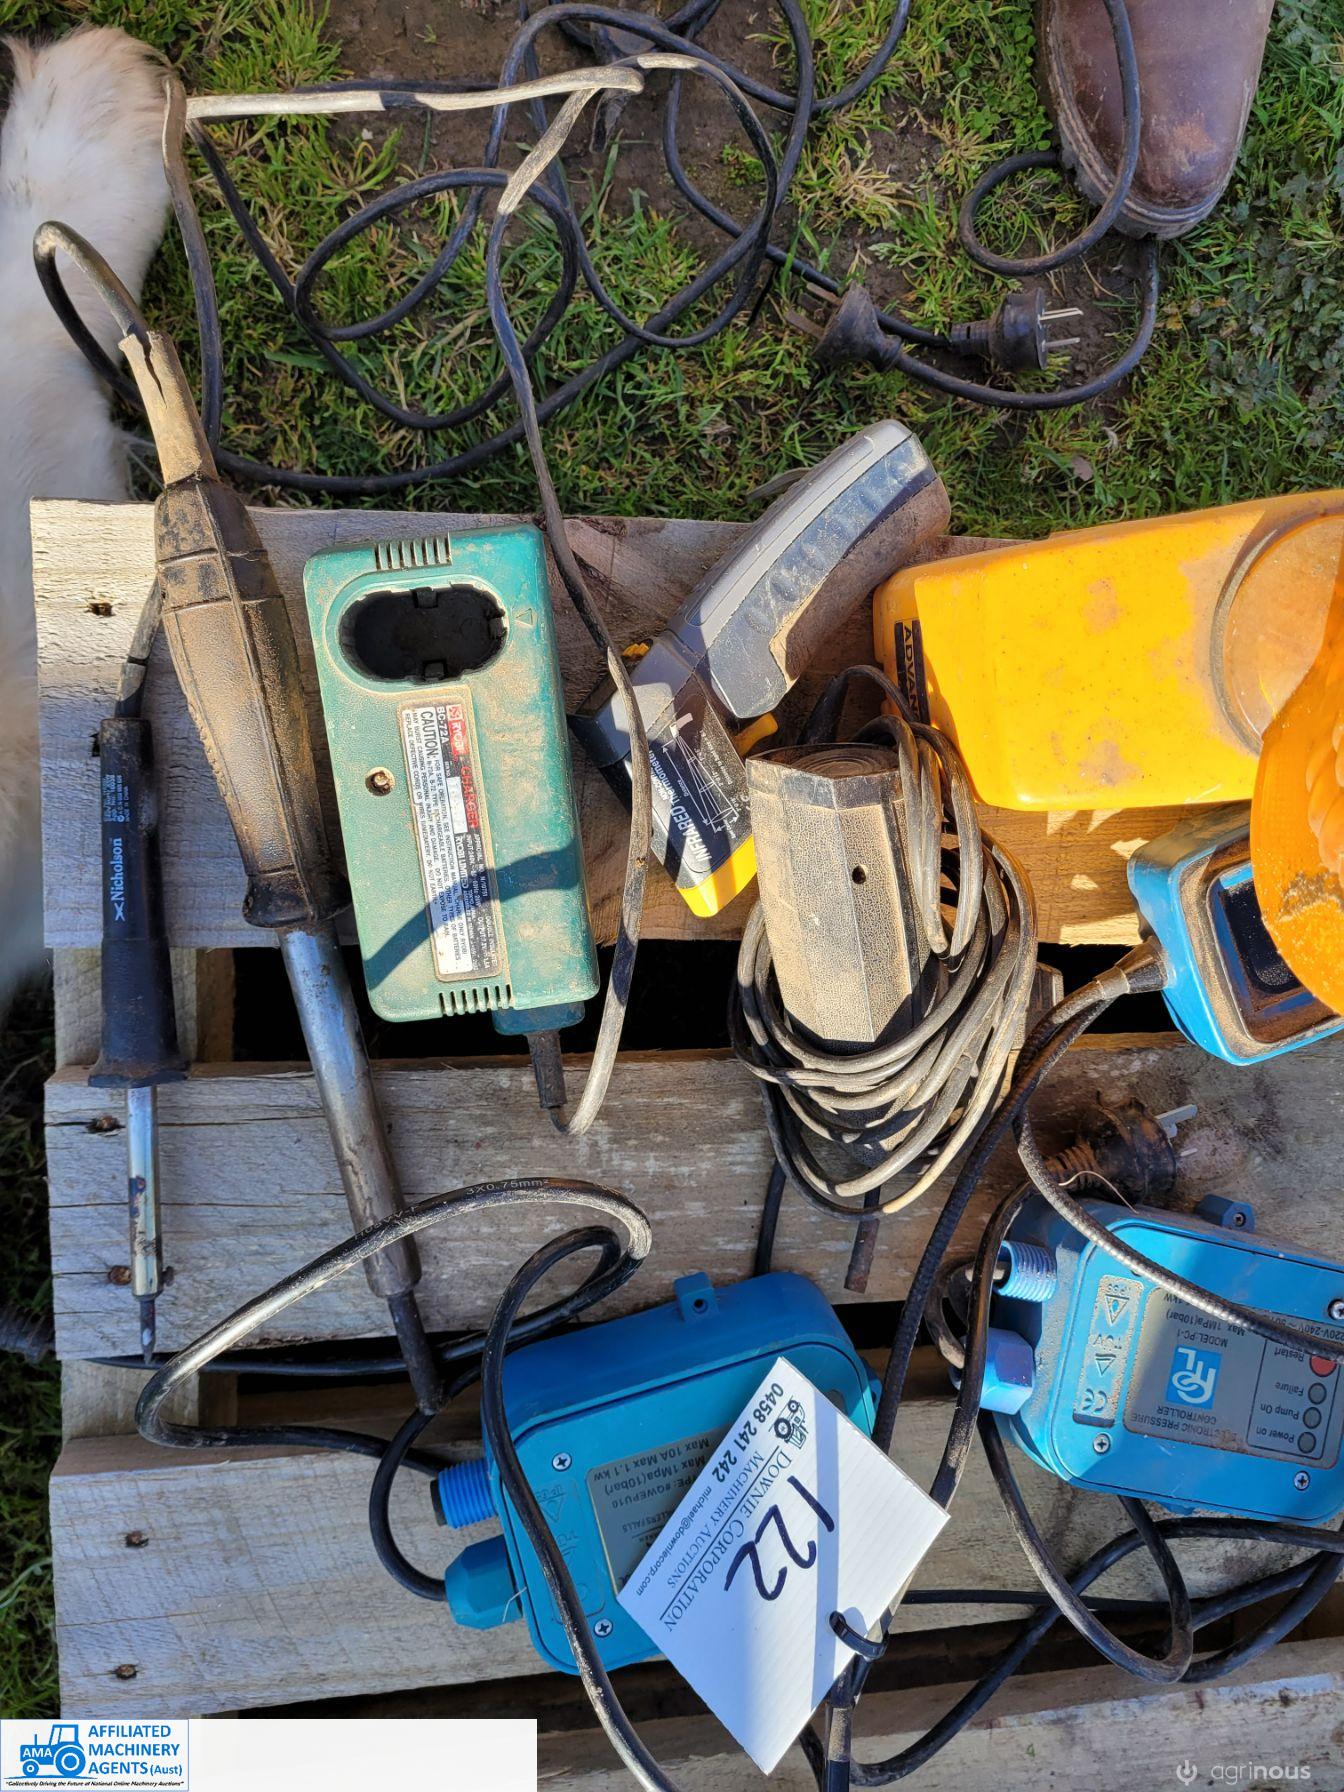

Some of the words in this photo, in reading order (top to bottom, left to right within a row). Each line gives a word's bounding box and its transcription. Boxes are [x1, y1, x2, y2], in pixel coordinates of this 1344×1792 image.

[404, 713, 413, 737] REPLACE
[419, 710, 439, 758] CAUTION:
[436, 706, 449, 743] BC-72A
[451, 721, 465, 752] RYOBI
[408, 739, 417, 768] DEFECTIVE
[416, 745, 425, 770] CAUSING
[420, 772, 430, 801] PERSONAL
[460, 765, 480, 828] CHARGER
[425, 802, 433, 822] INJURY
[455, 835, 464, 858] RYOBI
[473, 833, 482, 861] APPROVAL
[671, 804, 712, 862] INFRARED
[445, 834, 454, 869] INSTRUCTION
[108, 837, 124, 901] Nicholson
[458, 859, 469, 888] LIMITED
[438, 891, 446, 912] EXPOSE
[444, 885, 452, 903] OTHER
[1164, 1308, 1222, 1331] 1MPa(10bar)
[1176, 1328, 1228, 1347] MODEL:PC-1
[1273, 1347, 1304, 1362] Restart
[753, 1383, 784, 1422] 0458
[1273, 1381, 1304, 1396] Failure
[1129, 1411, 1179, 1430] PRESSURE
[1155, 1405, 1217, 1424] CONTROLLER
[1259, 1403, 1273, 1414] On
[1273, 1404, 1300, 1419] Pump
[684, 1437, 708, 1452] Max
[732, 1414, 756, 1454] 241
[1254, 1425, 1267, 1436] on
[1268, 1429, 1295, 1443] Power
[632, 1454, 658, 1469] Max
[659, 1446, 680, 1460] 10A
[680, 1454, 705, 1469] Max
[712, 1444, 737, 1483] 242
[603, 1463, 678, 1495] 1Mpa(10bar)
[710, 1451, 765, 1530] MACHINERY
[740, 1449, 792, 1518] DOWNIE
[636, 1485, 713, 1597] michael@downiecorp.com
[723, 1476, 835, 1602] 122
[667, 1525, 713, 1588] AUCTIONS
[661, 1517, 745, 1632] CORPORATION
